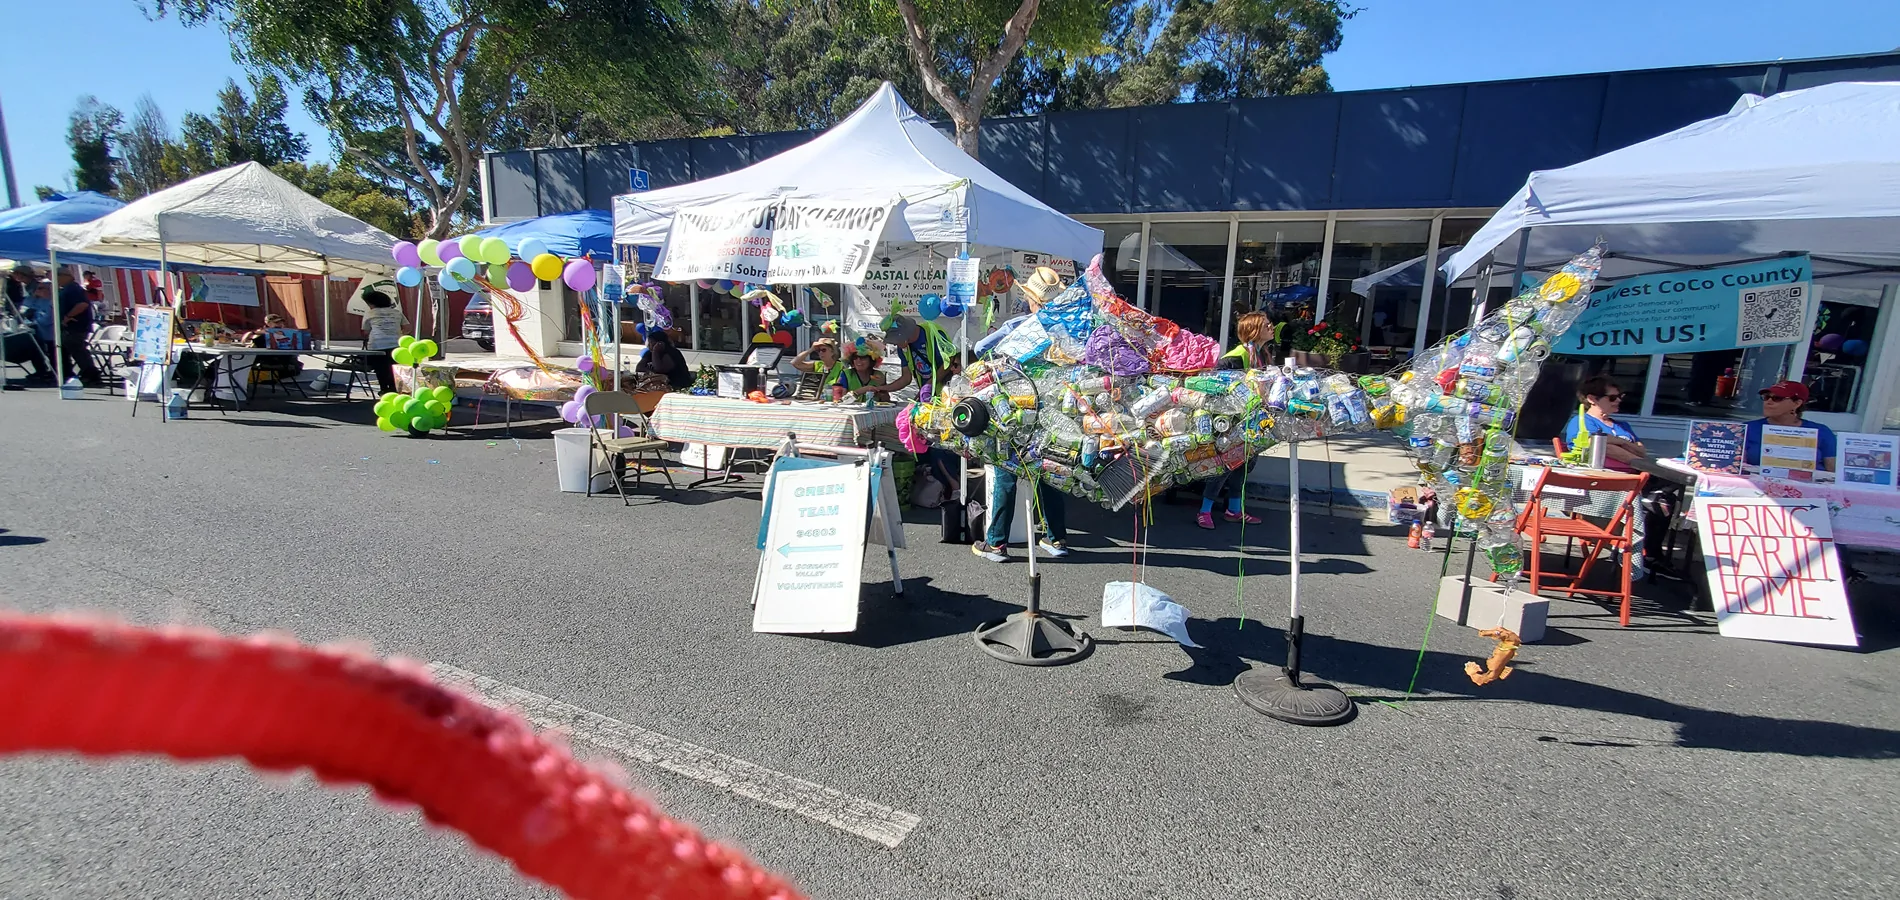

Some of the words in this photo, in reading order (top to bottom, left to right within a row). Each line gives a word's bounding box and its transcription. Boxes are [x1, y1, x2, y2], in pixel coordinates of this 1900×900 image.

[743, 237, 771, 246] 94803
[737, 247, 772, 258] NEEDED
[1050, 259, 1073, 268] WAYS
[724, 262, 733, 273] El
[736, 263, 776, 278] Sobrante
[812, 264, 822, 276] 10
[865, 270, 909, 281] OASTAL
[914, 269, 948, 280] CLEAN
[872, 283, 890, 292] Sept.
[912, 283, 930, 291] 9:30
[1606, 283, 1652, 302] West
[1658, 278, 1714, 294] CoCo
[1721, 267, 1803, 288] County
[857, 320, 882, 329] Cigaret
[1576, 327, 1643, 350] JOIN
[1656, 323, 1706, 343] US!
[794, 483, 845, 498] GREEN
[798, 505, 840, 518] TEAM
[1707, 503, 1814, 539] BRING
[796, 527, 837, 539] 94803
[1720, 573, 1823, 619] HOME
